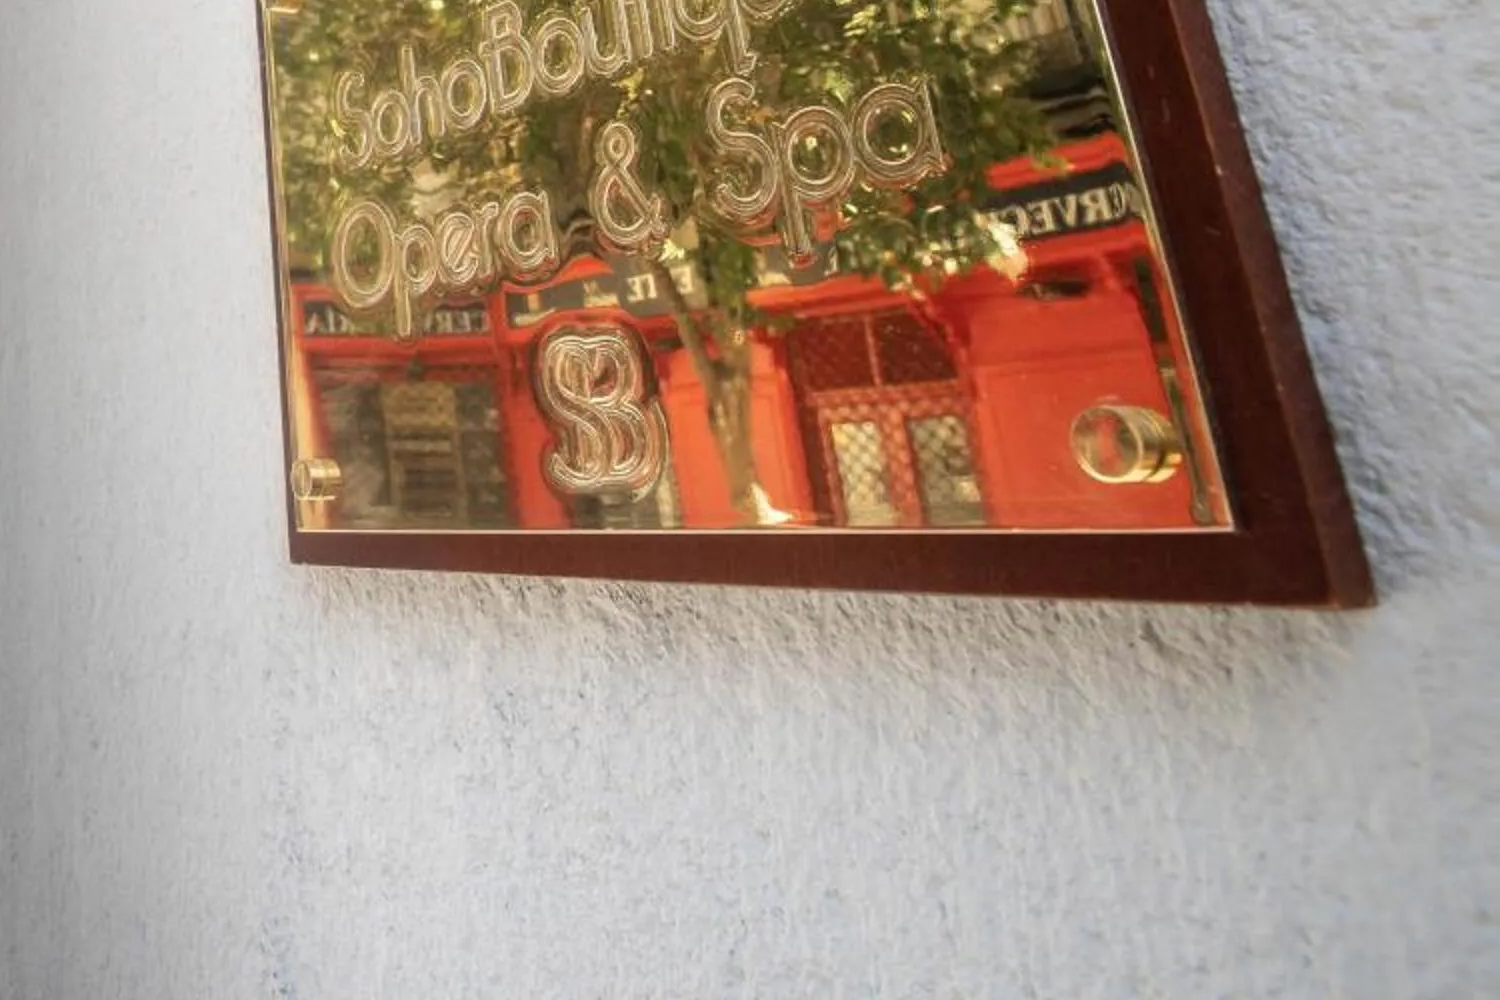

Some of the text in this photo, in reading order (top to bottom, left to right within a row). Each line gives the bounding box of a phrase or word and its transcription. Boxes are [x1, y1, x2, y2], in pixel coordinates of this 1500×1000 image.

[333, 190, 558, 338] Opera
[596, 122, 668, 248] &
[706, 77, 947, 258] Spa
